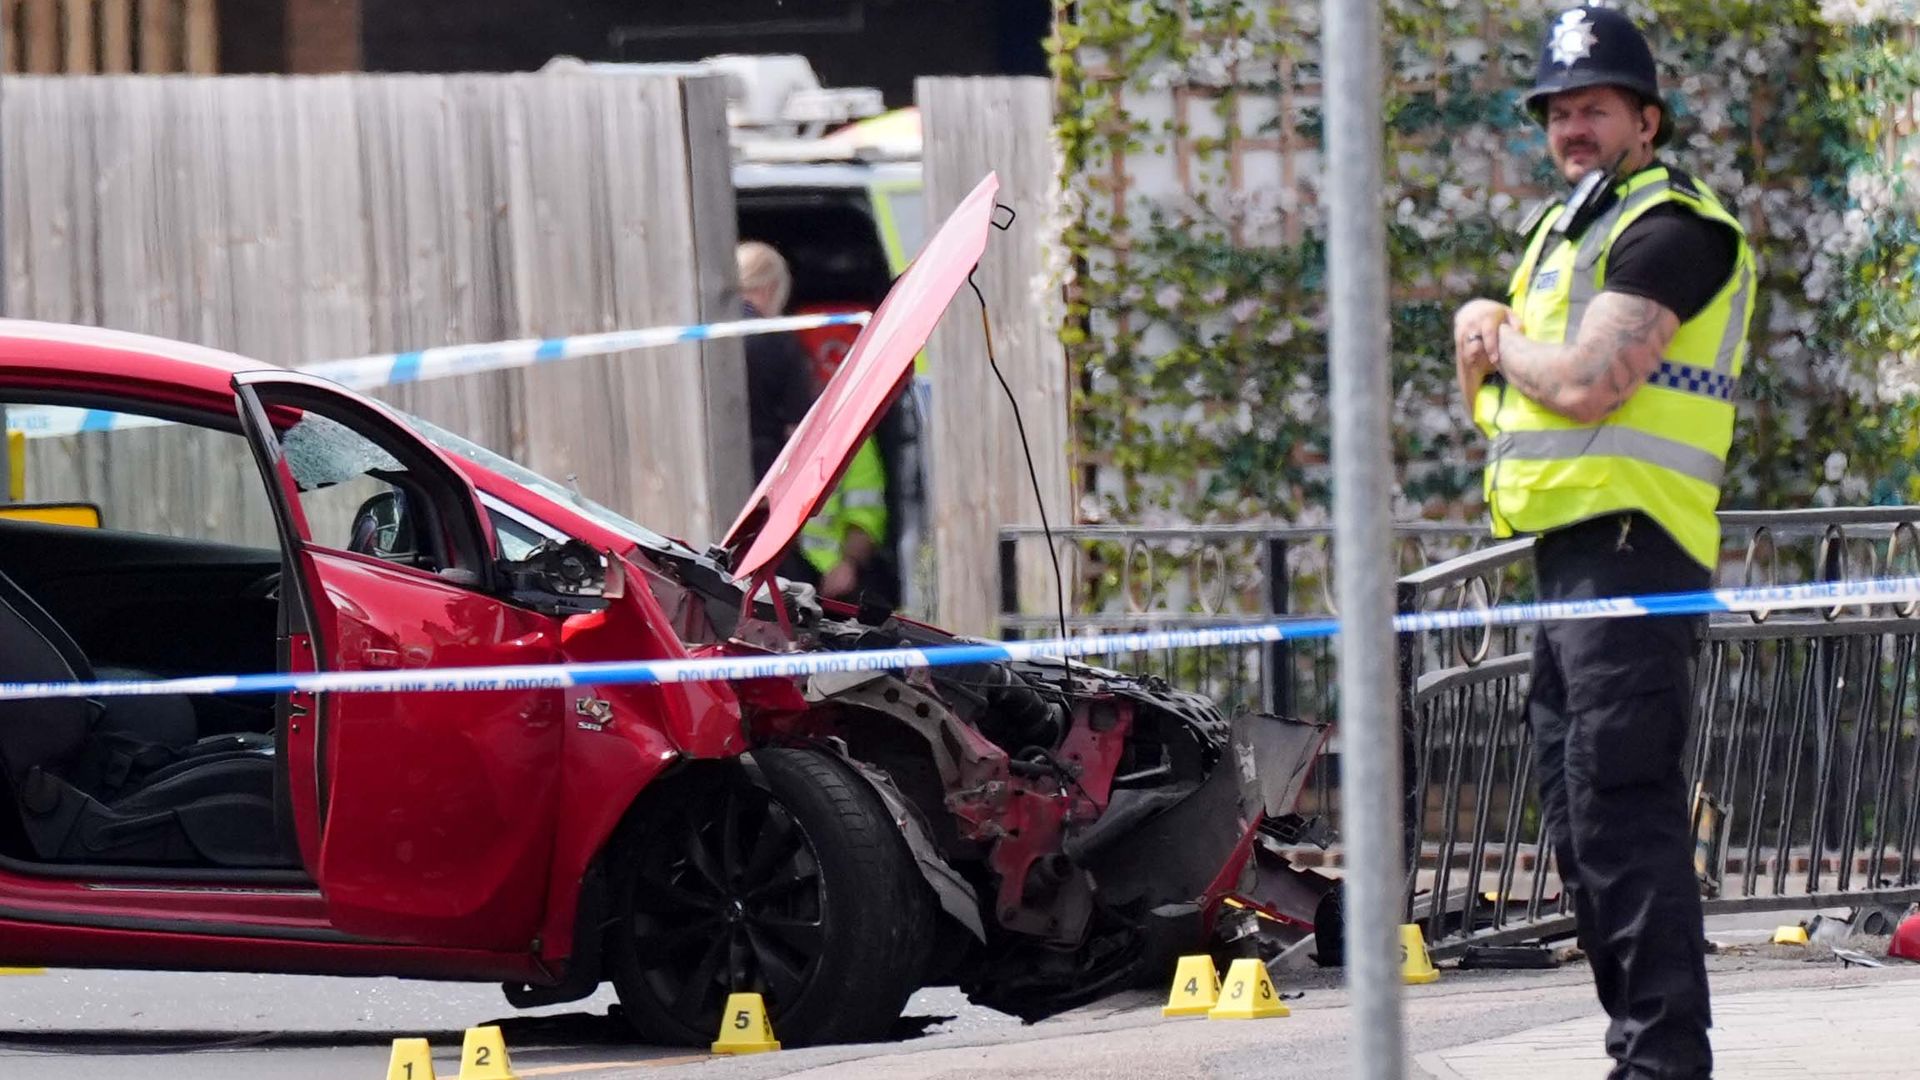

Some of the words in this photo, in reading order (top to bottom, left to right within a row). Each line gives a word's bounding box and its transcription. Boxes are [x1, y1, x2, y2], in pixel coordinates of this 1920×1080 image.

[677, 666, 735, 681] POLICE
[742, 664, 778, 678] LINE
[786, 661, 809, 676] DO
[815, 659, 848, 673] NOT
[856, 654, 913, 670] CROSS
[1184, 977, 1199, 996] 4
[1231, 981, 1245, 999] 3
[1260, 980, 1271, 1000] 3
[734, 1010, 750, 1029] 5
[475, 1046, 491, 1066] 2
[403, 1062, 413, 1080] 1
